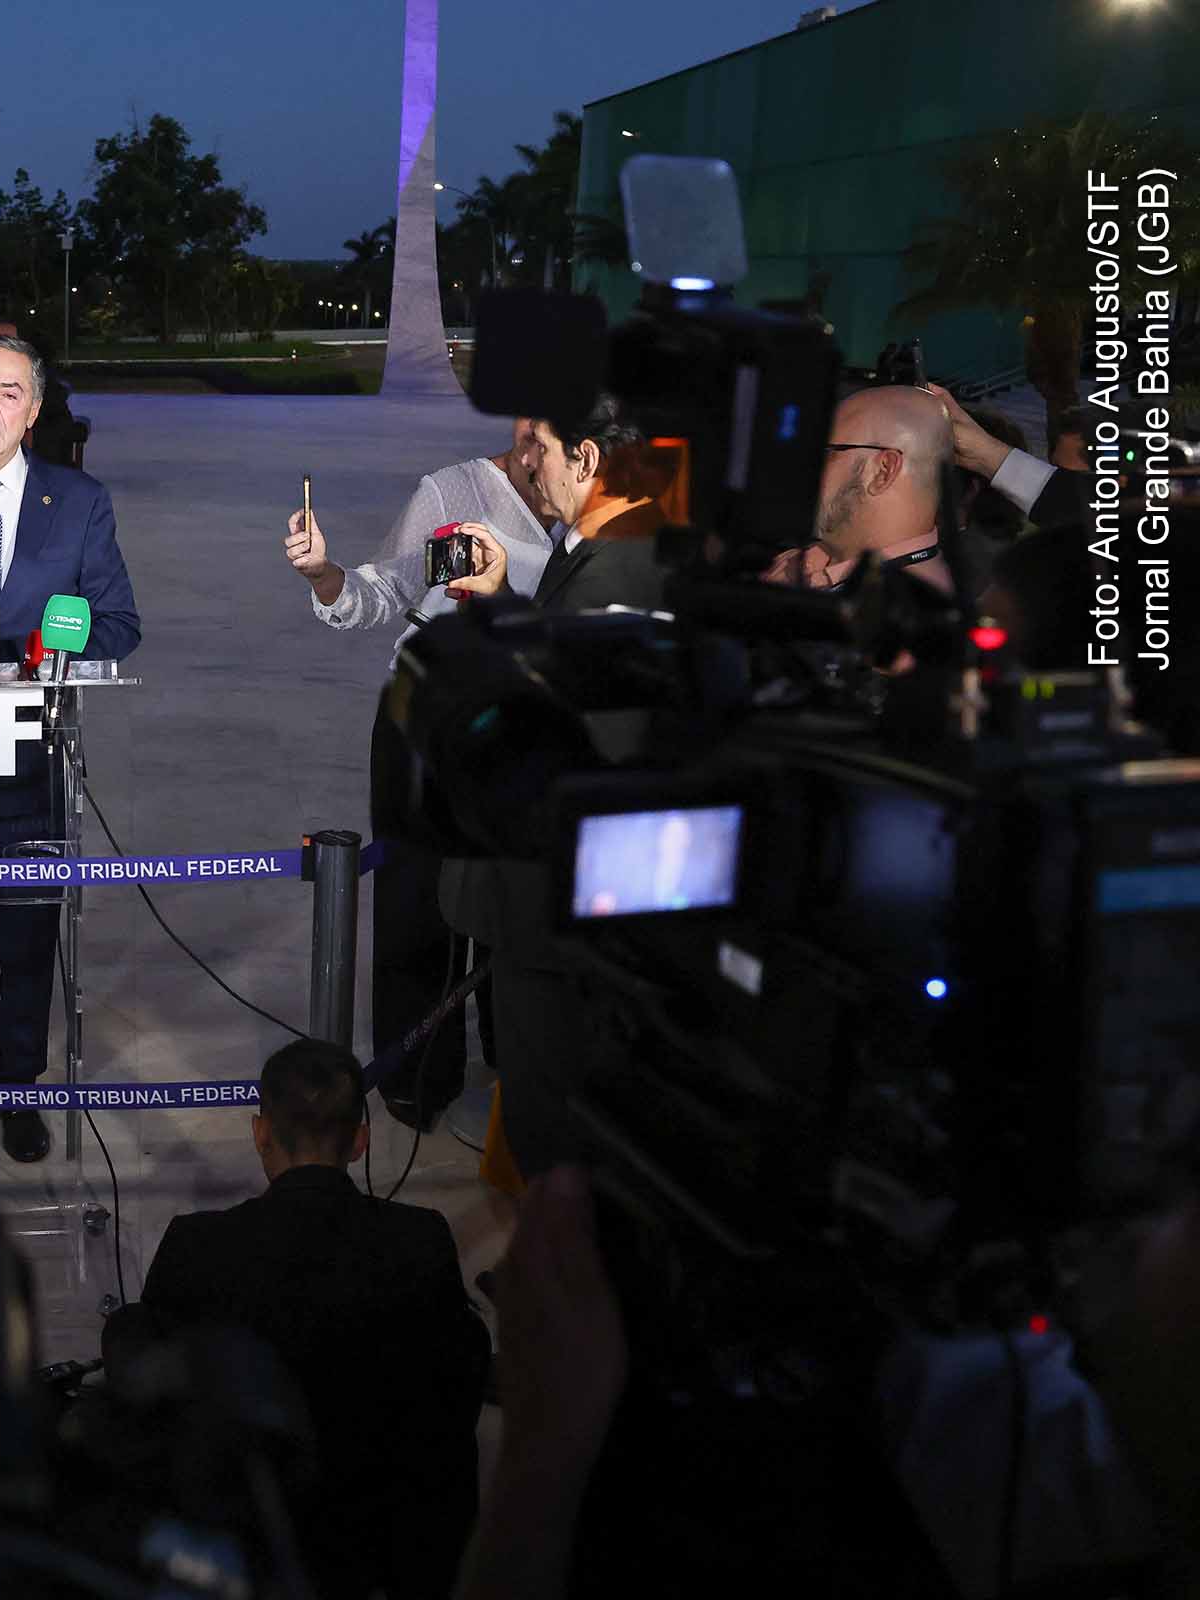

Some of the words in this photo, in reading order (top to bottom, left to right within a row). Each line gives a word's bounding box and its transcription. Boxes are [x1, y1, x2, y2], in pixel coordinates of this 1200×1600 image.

[76, 861, 182, 880] TRIBUNAL
[187, 857, 282, 876] FEDERAL
[74, 1089, 176, 1105] TRIBUNAL
[181, 1085, 260, 1102] FEDERA
